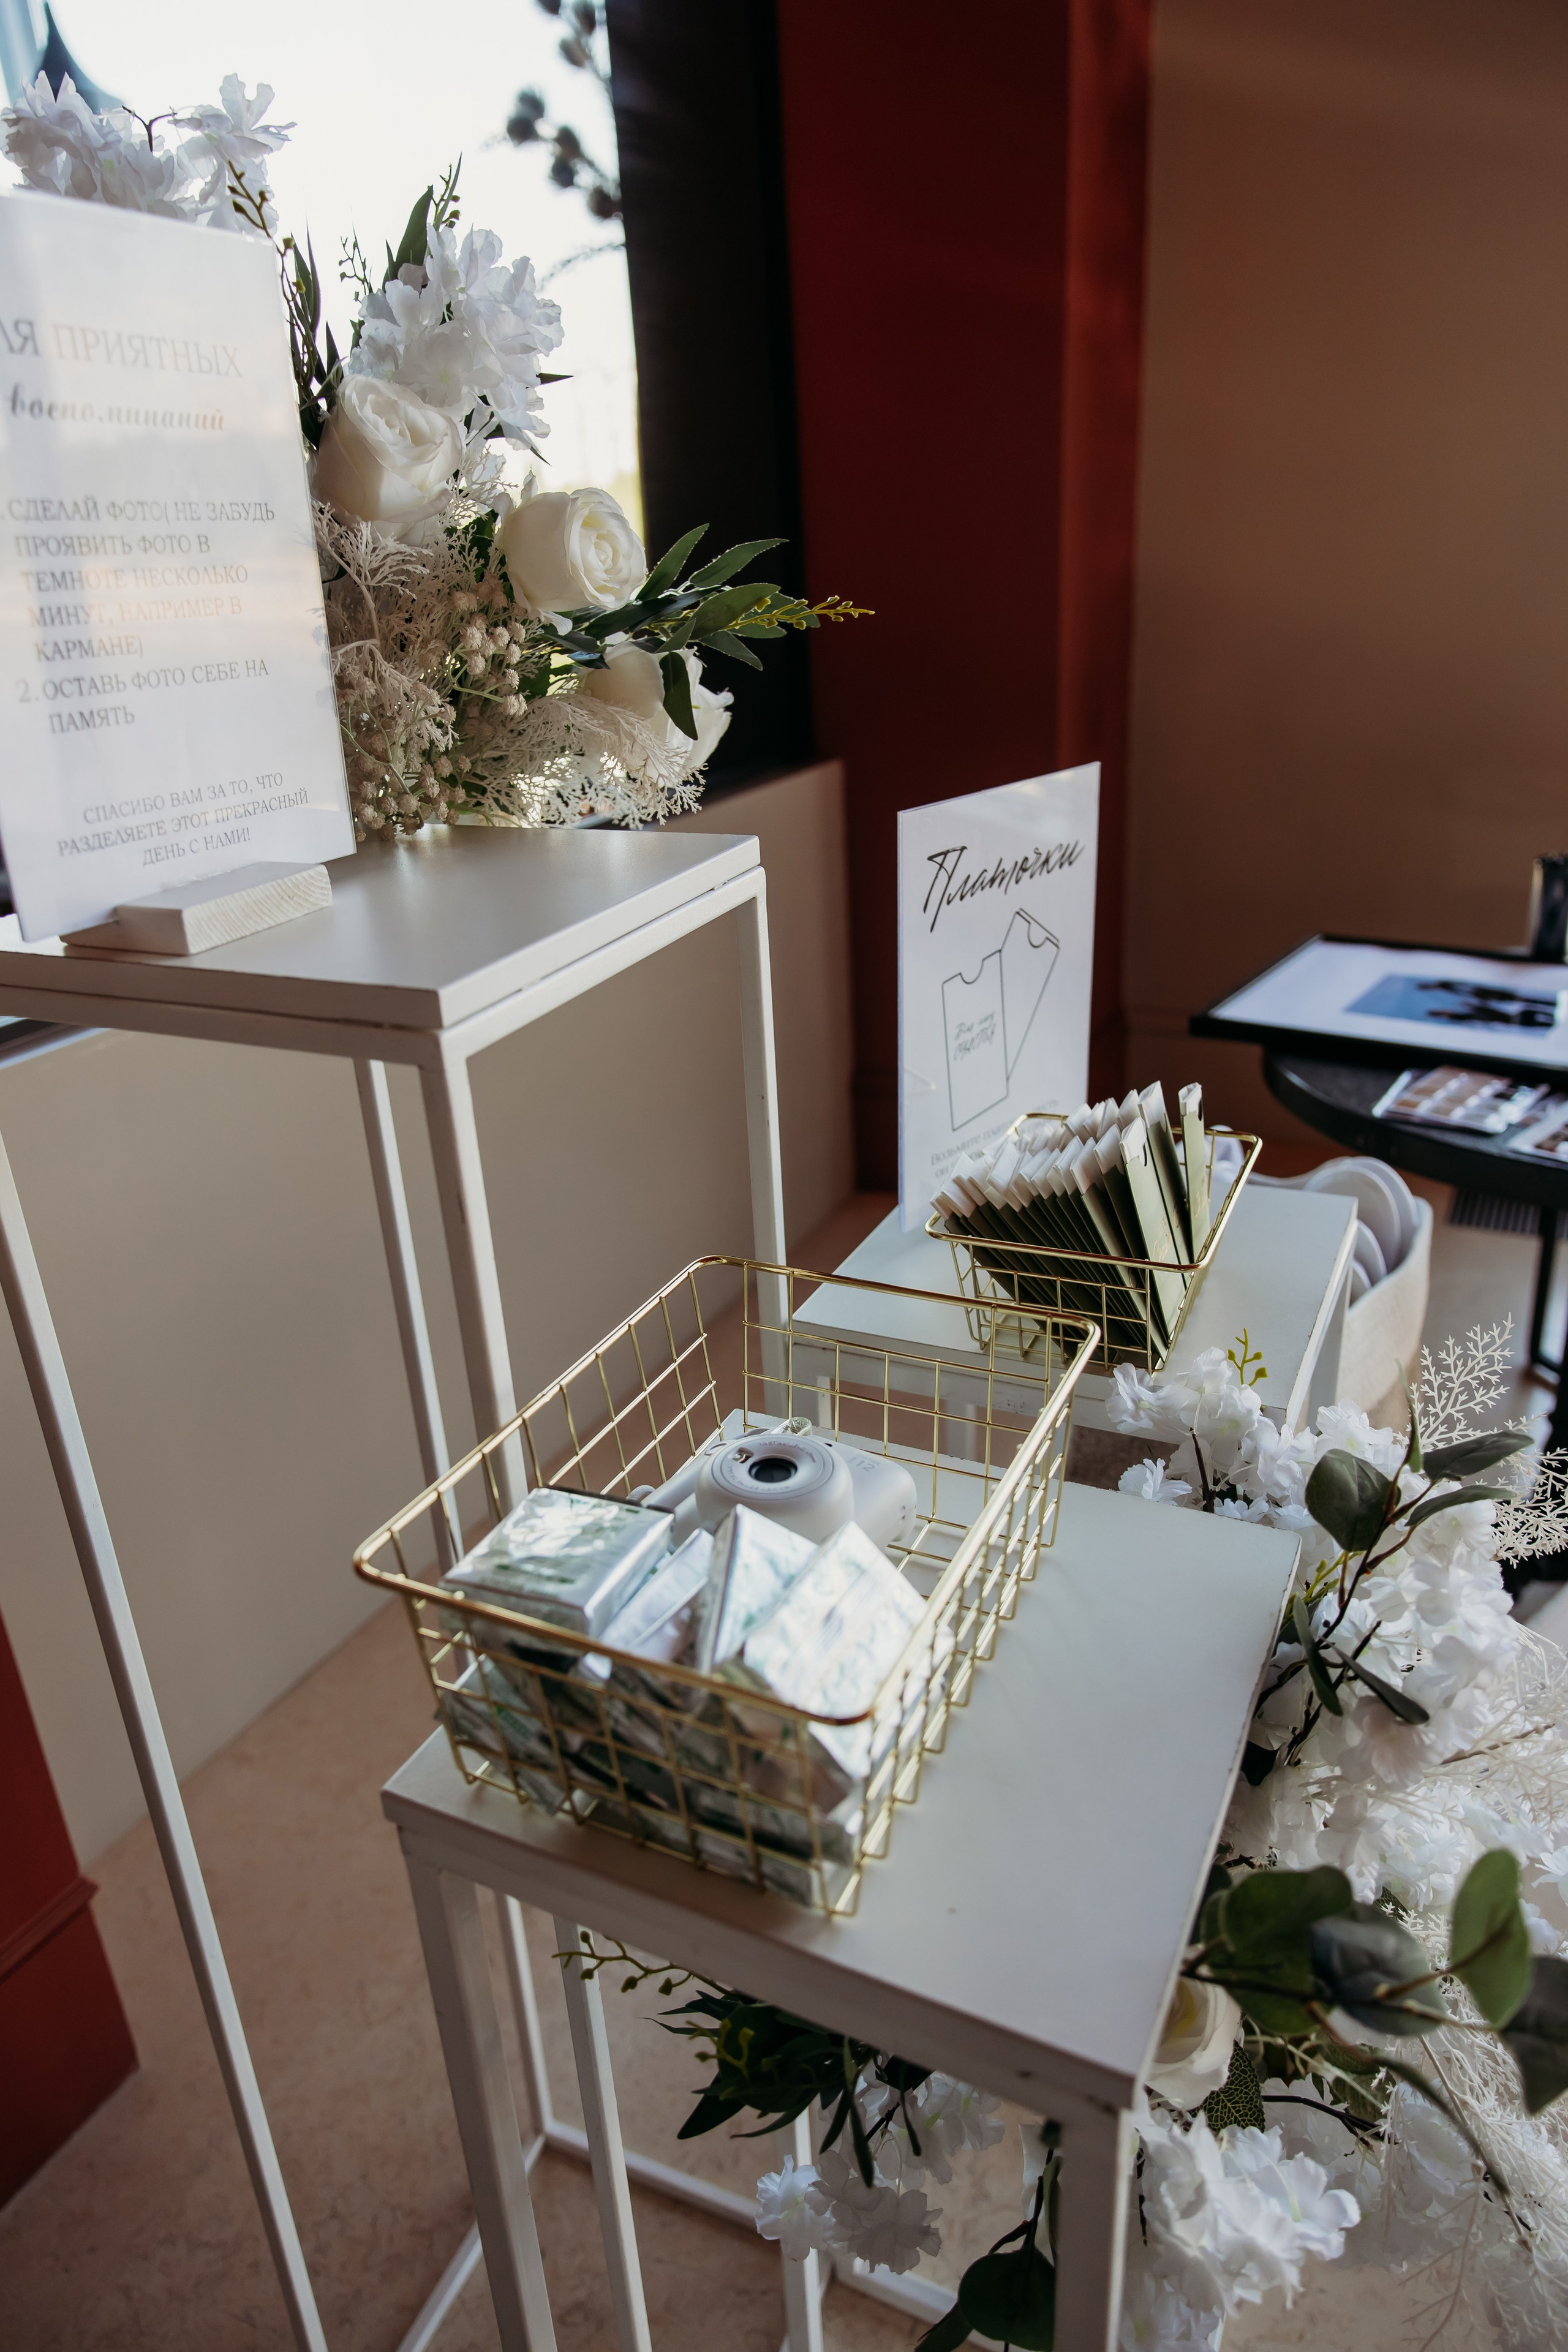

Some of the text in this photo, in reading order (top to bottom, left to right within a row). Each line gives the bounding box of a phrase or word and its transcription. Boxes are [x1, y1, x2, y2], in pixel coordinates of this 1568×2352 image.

[53, 323, 243, 379] ПРИЯТНЫХ
[8, 495, 100, 523] СДЕЛАЙ
[174, 502, 201, 521] НЕ
[206, 501, 275, 524] ЗАБУДЬ
[15, 533, 211, 557] ПРОЯВИТЬ ФОТО В
[20, 565, 248, 592] ТЕМНОТЕ НЕСКОЛЬКО
[118, 597, 224, 622] НАПРИМЕР
[230, 597, 243, 615] В
[34, 635, 143, 663] КАРМАНЕ)
[16, 658, 269, 703] 2. ОСТАВЬ ФОТО СЕБЕ НА
[48, 706, 135, 734] ПАМЯТЬ
[83, 772, 284, 824] СПАСИБО ВАМ ЗА ТО, ЧТО
[58, 787, 309, 857] РАЗДЕЛЯЕТЕ ЭТОТ ПРЕКРАСНЫЙ
[142, 826, 251, 867] ДЕНЬ С НАМИ!
[923, 840, 1086, 933] Платочки
